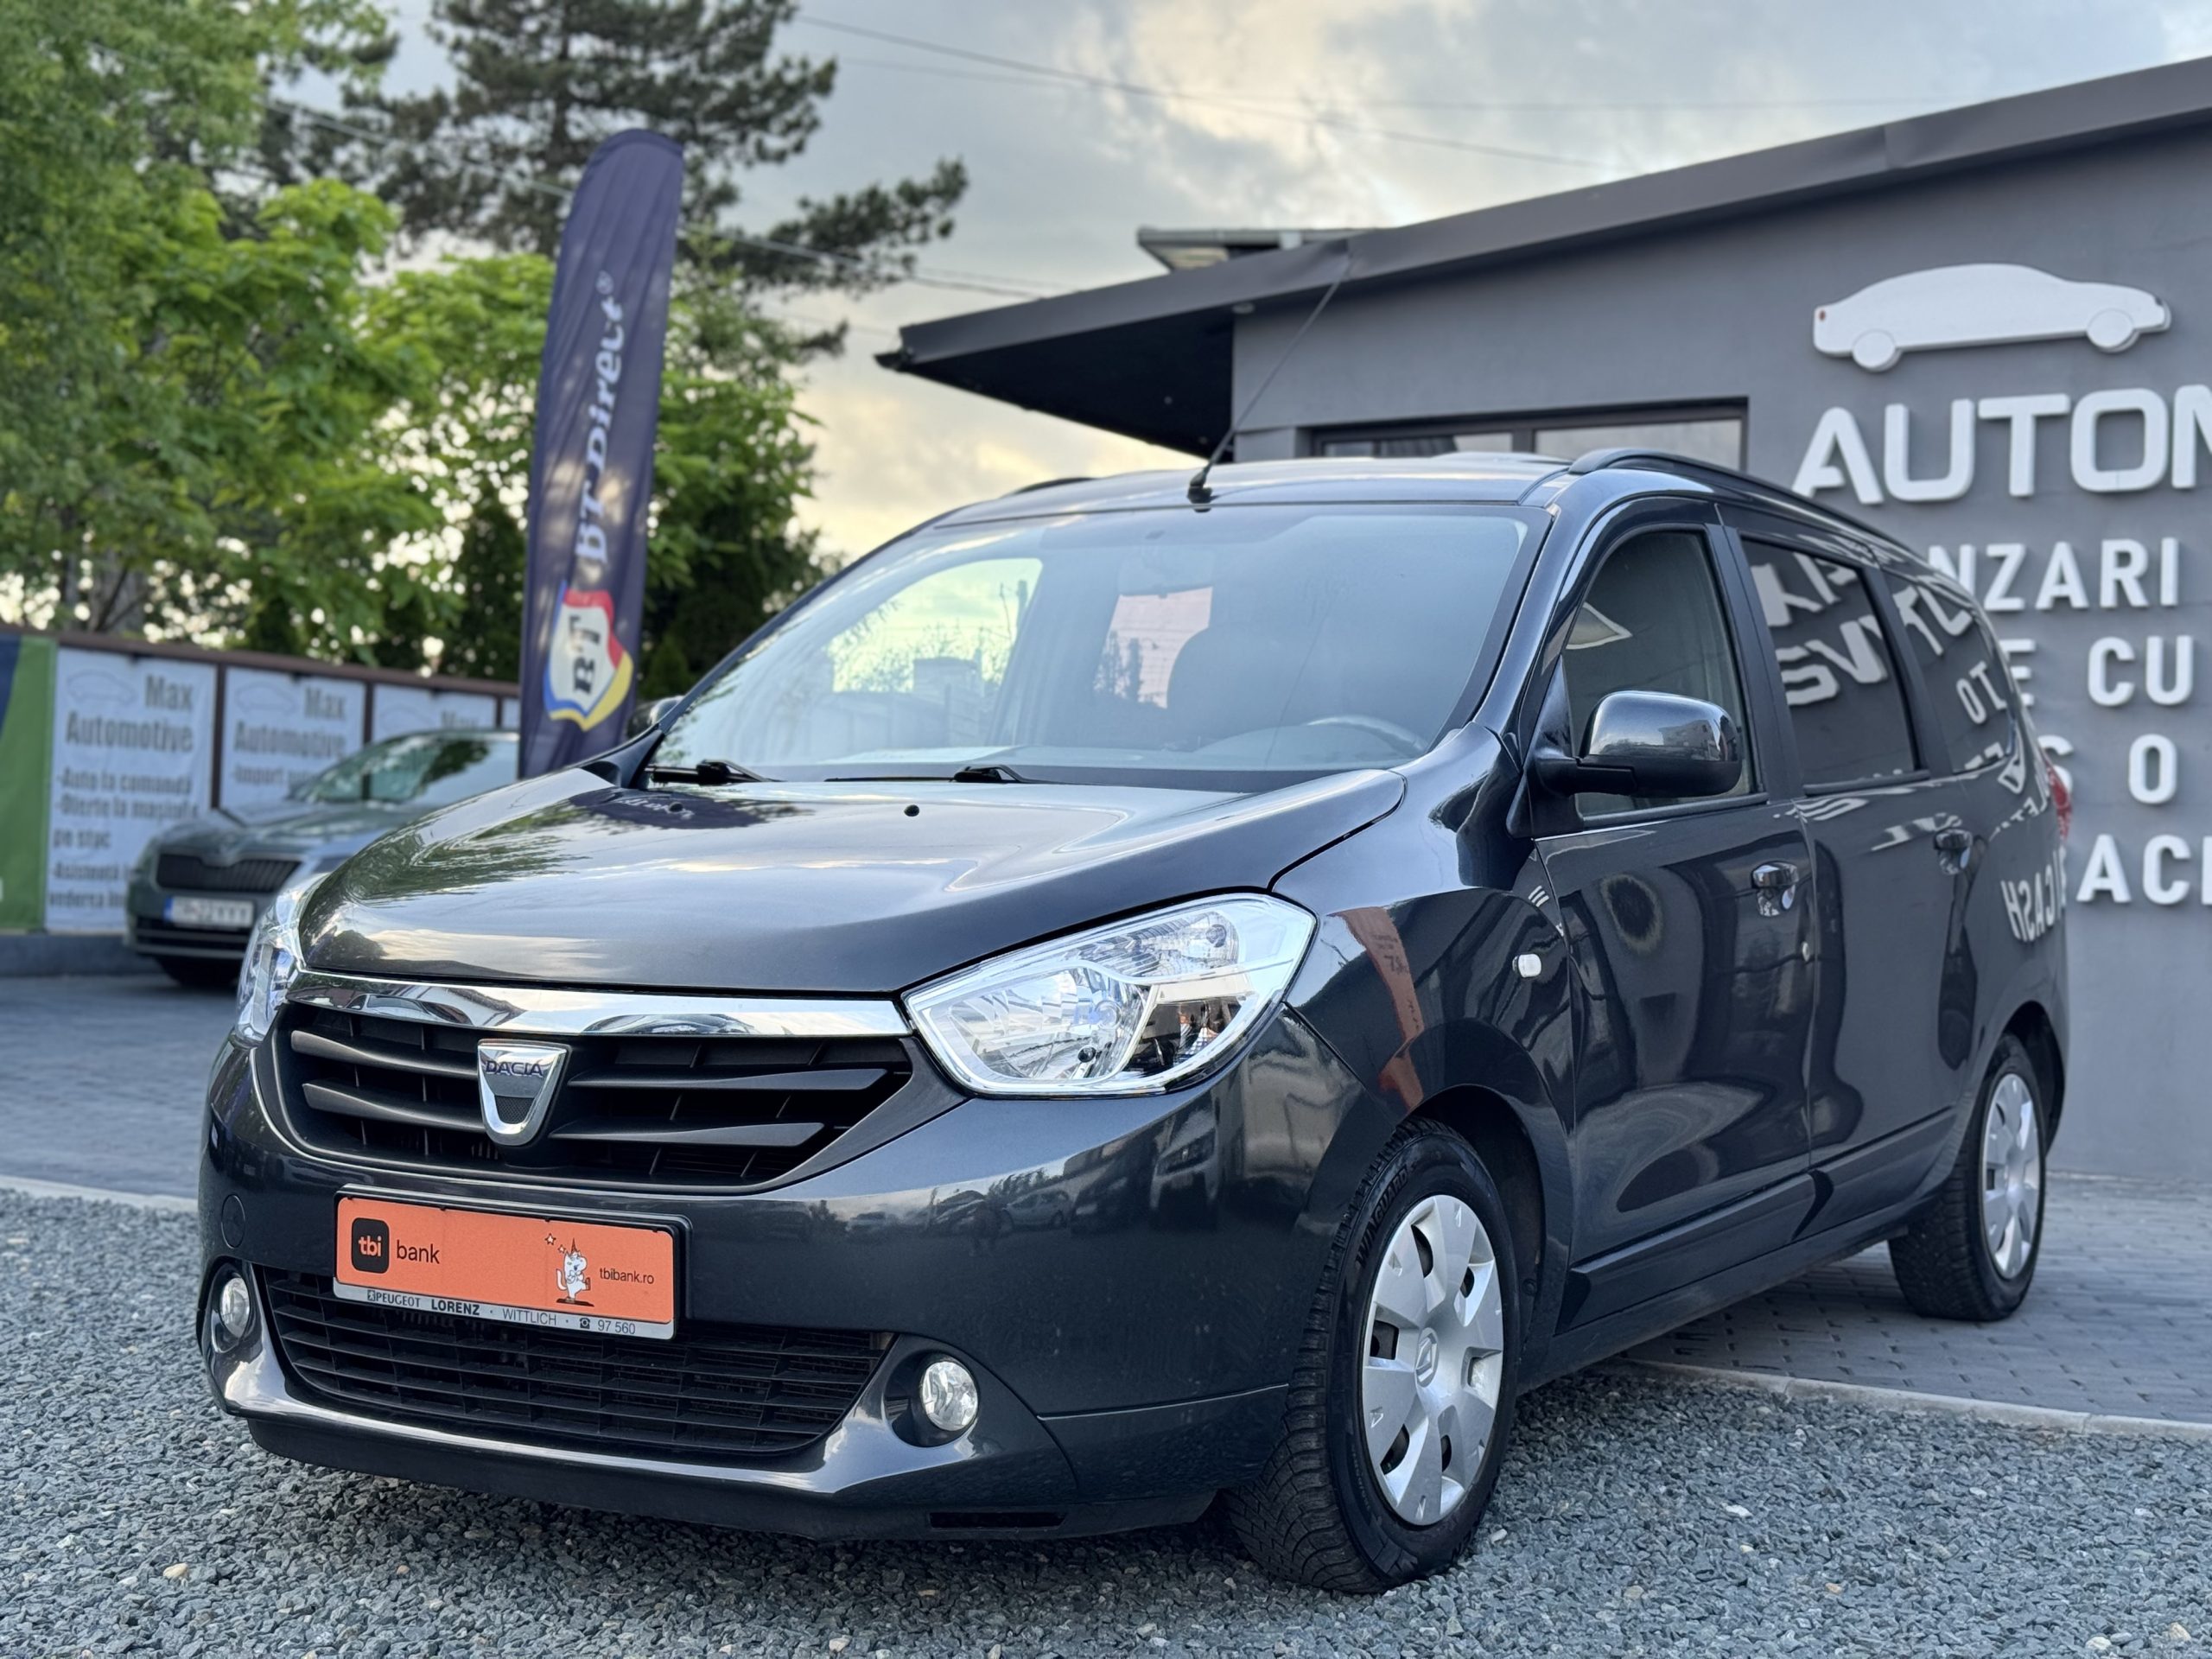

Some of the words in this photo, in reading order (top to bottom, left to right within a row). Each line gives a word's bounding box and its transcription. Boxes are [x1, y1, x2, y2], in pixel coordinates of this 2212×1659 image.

[1929, 537, 2180, 613] NZARI
[2088, 634, 2194, 707] CU
[146, 675, 193, 710] Max
[304, 686, 347, 722] Max
[65, 709, 194, 753] Automotive
[486, 1060, 543, 1077] DACIA
[359, 1236, 382, 1257] tbi
[397, 1239, 440, 1264] bank
[600, 1268, 654, 1285] tbibank.ro
[376, 1291, 422, 1308] PEUGEOT
[431, 1299, 480, 1316] LORENZ
[502, 1307, 557, 1326] WITTLICH
[597, 1320, 612, 1332] 97
[614, 1321, 636, 1336] 560
